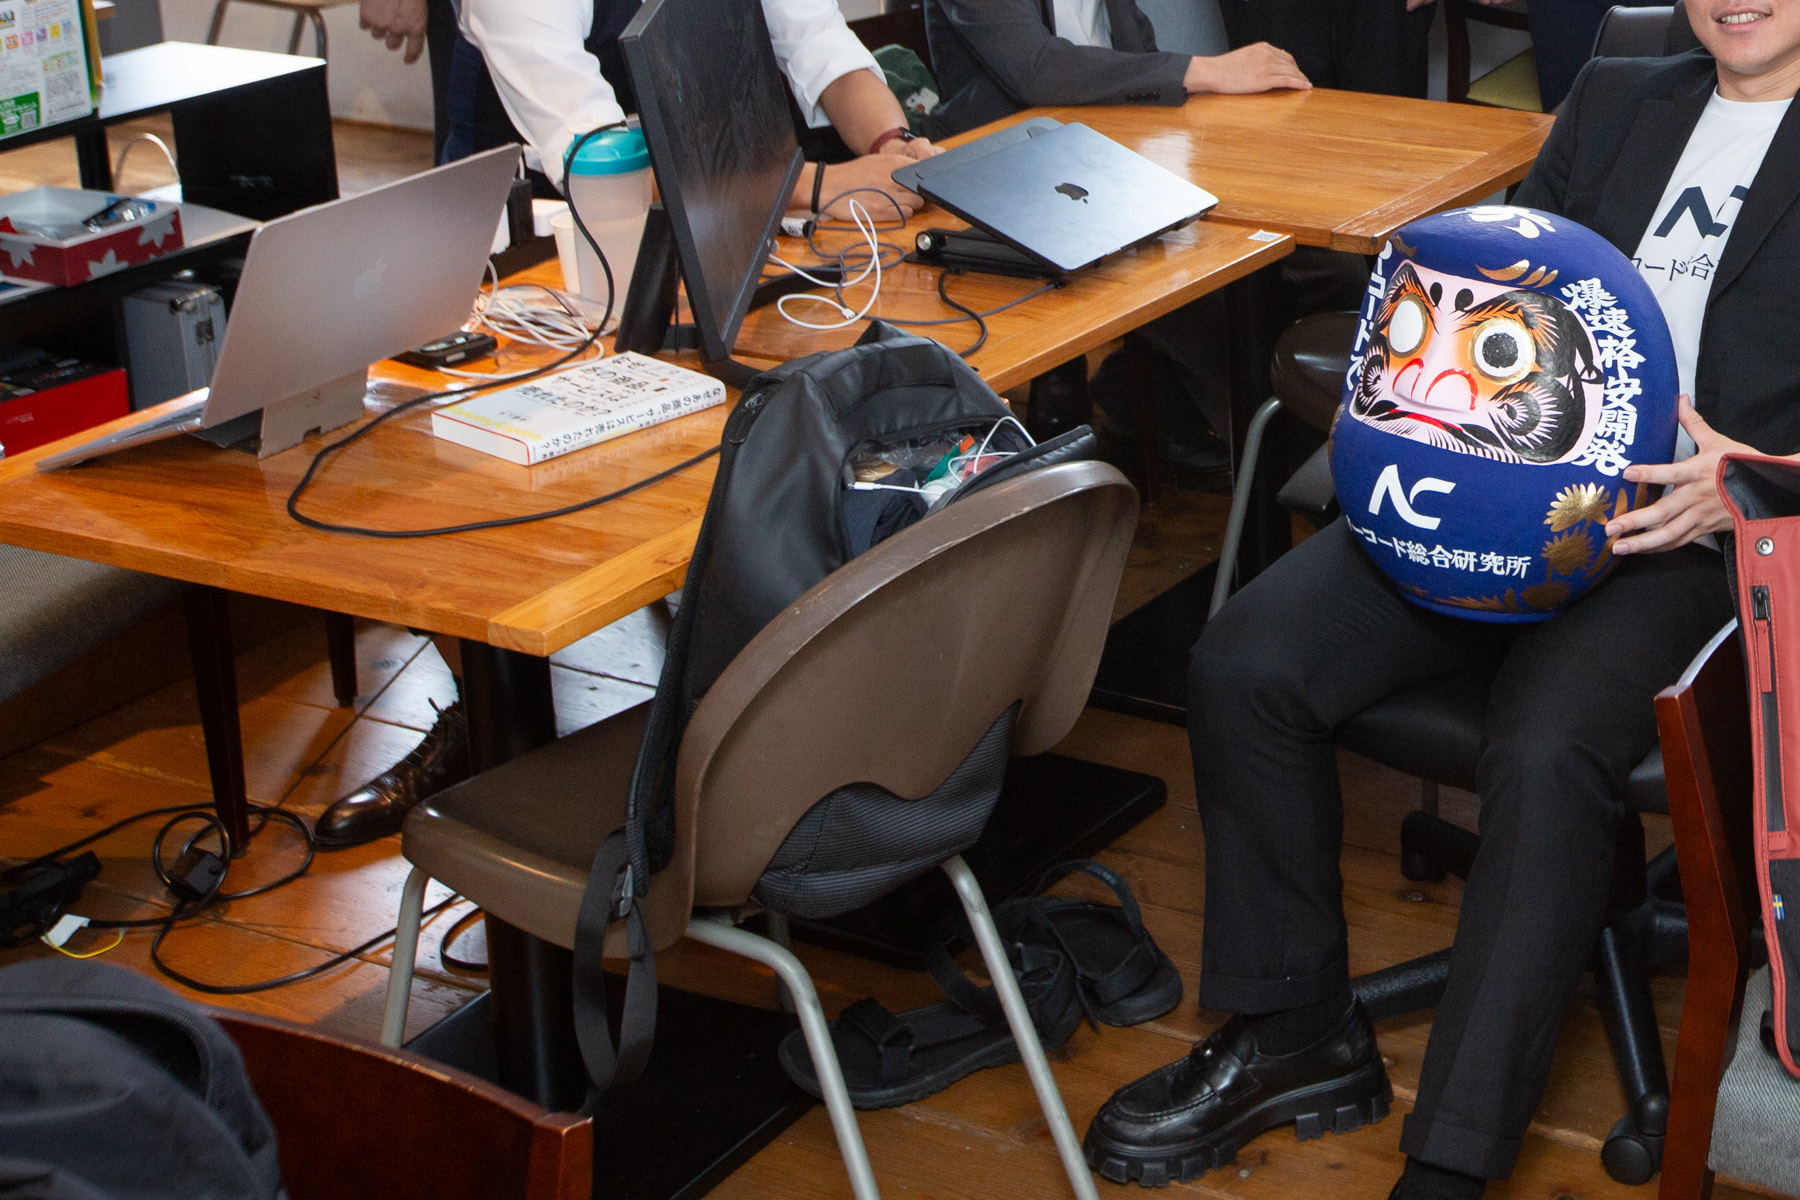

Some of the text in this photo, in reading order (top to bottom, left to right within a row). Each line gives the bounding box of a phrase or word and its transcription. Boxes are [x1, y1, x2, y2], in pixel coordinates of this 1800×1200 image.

[1560, 277, 1647, 477] 爆速格安開発
